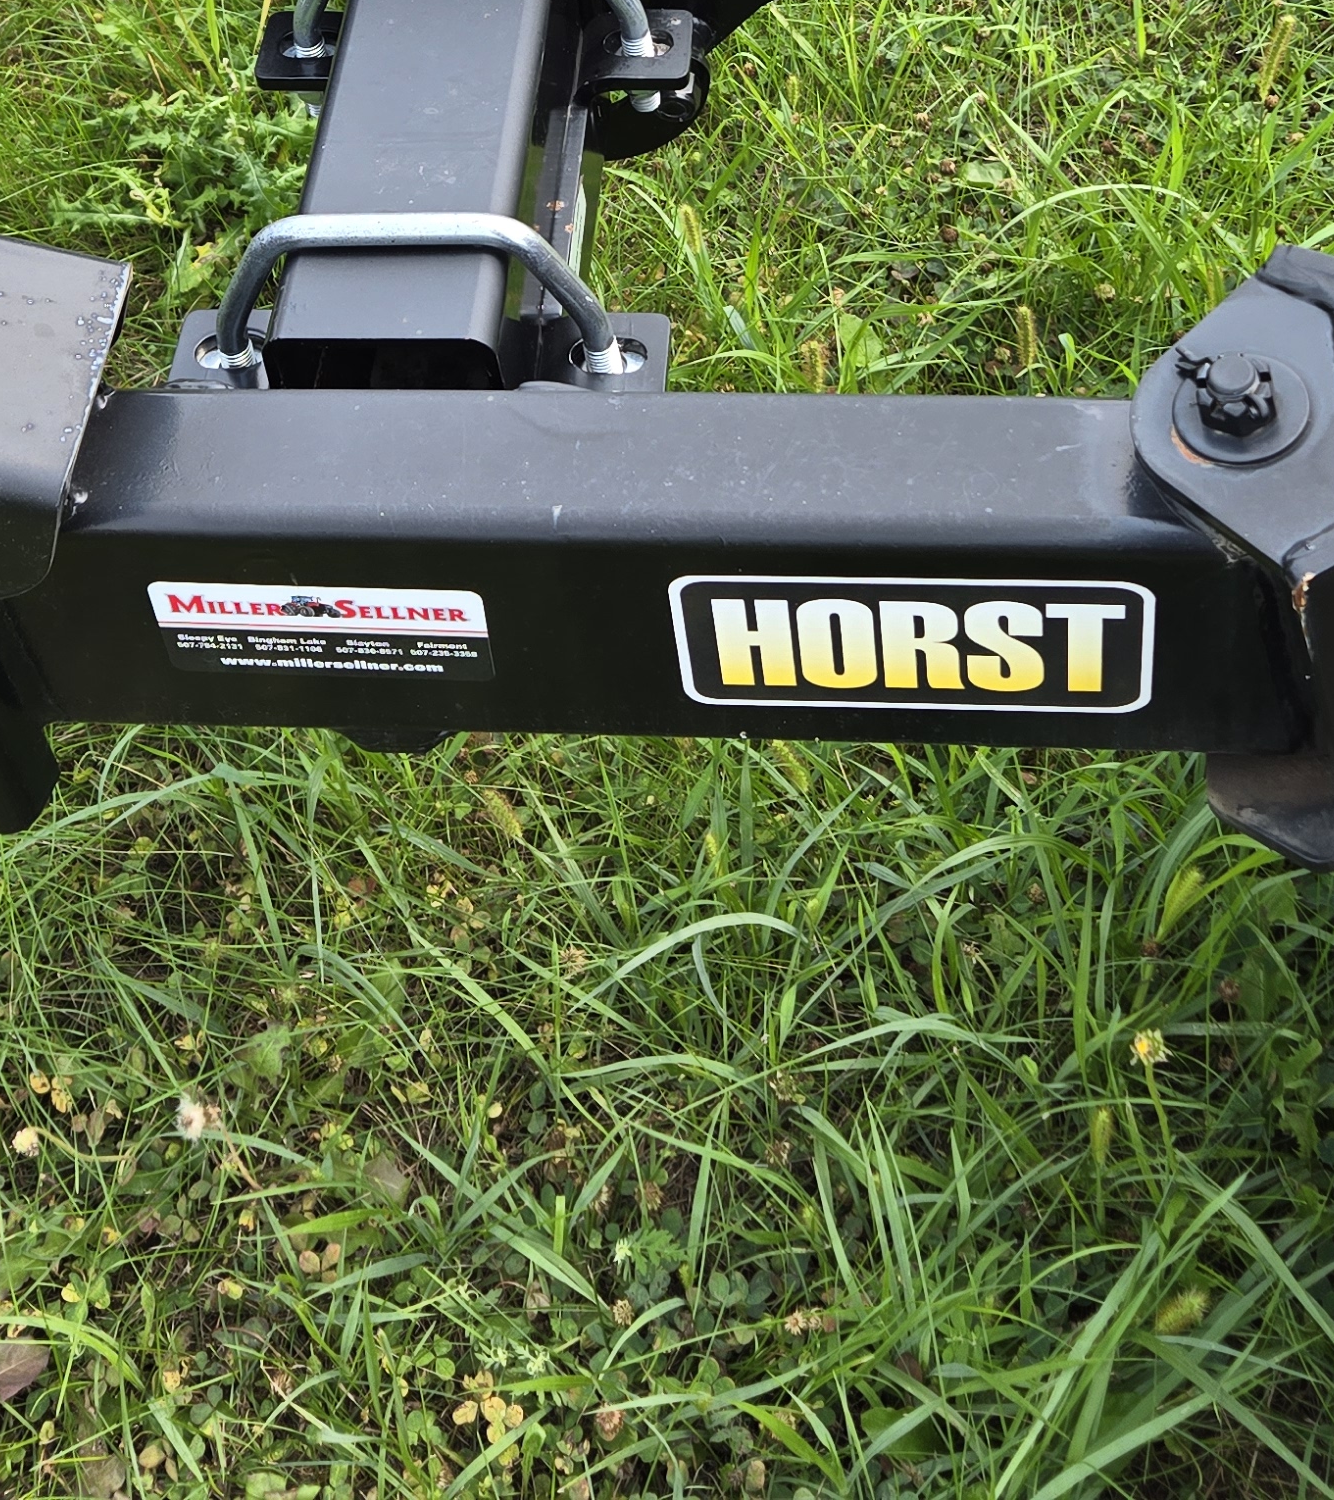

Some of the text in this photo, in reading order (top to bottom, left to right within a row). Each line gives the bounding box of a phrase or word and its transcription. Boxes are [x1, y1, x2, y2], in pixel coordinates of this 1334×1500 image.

[165, 594, 471, 622] MILLER SELLNER
[299, 637, 327, 646] Lake
[710, 598, 1127, 692] HORST
[220, 657, 445, 673] www.millersellner.com
